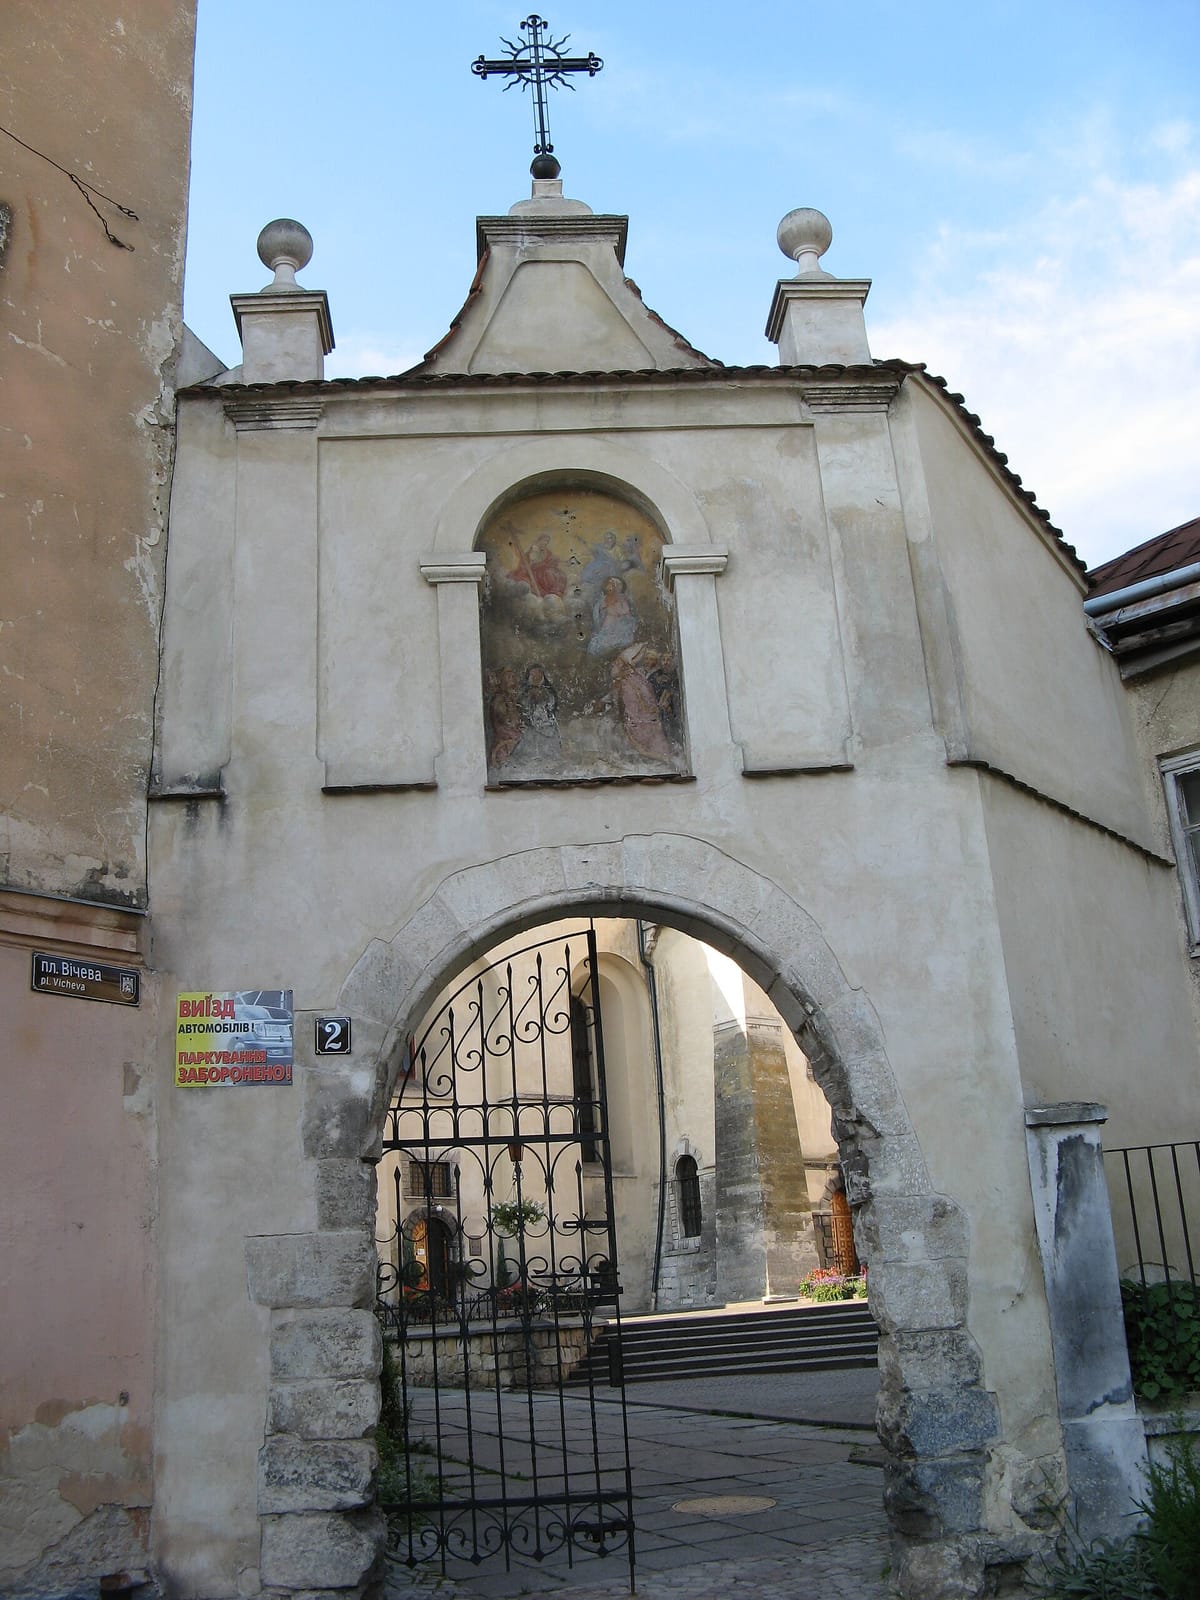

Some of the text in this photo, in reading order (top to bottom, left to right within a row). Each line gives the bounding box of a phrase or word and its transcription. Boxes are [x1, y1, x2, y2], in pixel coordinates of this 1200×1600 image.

[41, 960, 102, 982] пл. Вічева
[53, 978, 86, 991] Vicheva
[179, 994, 236, 1020] ВИЇЗД
[324, 1022, 342, 1050] 2
[178, 1049, 267, 1065] ПАРКУВАННЯ
[178, 1065, 292, 1084] ЗАБОРОНЕНО!
